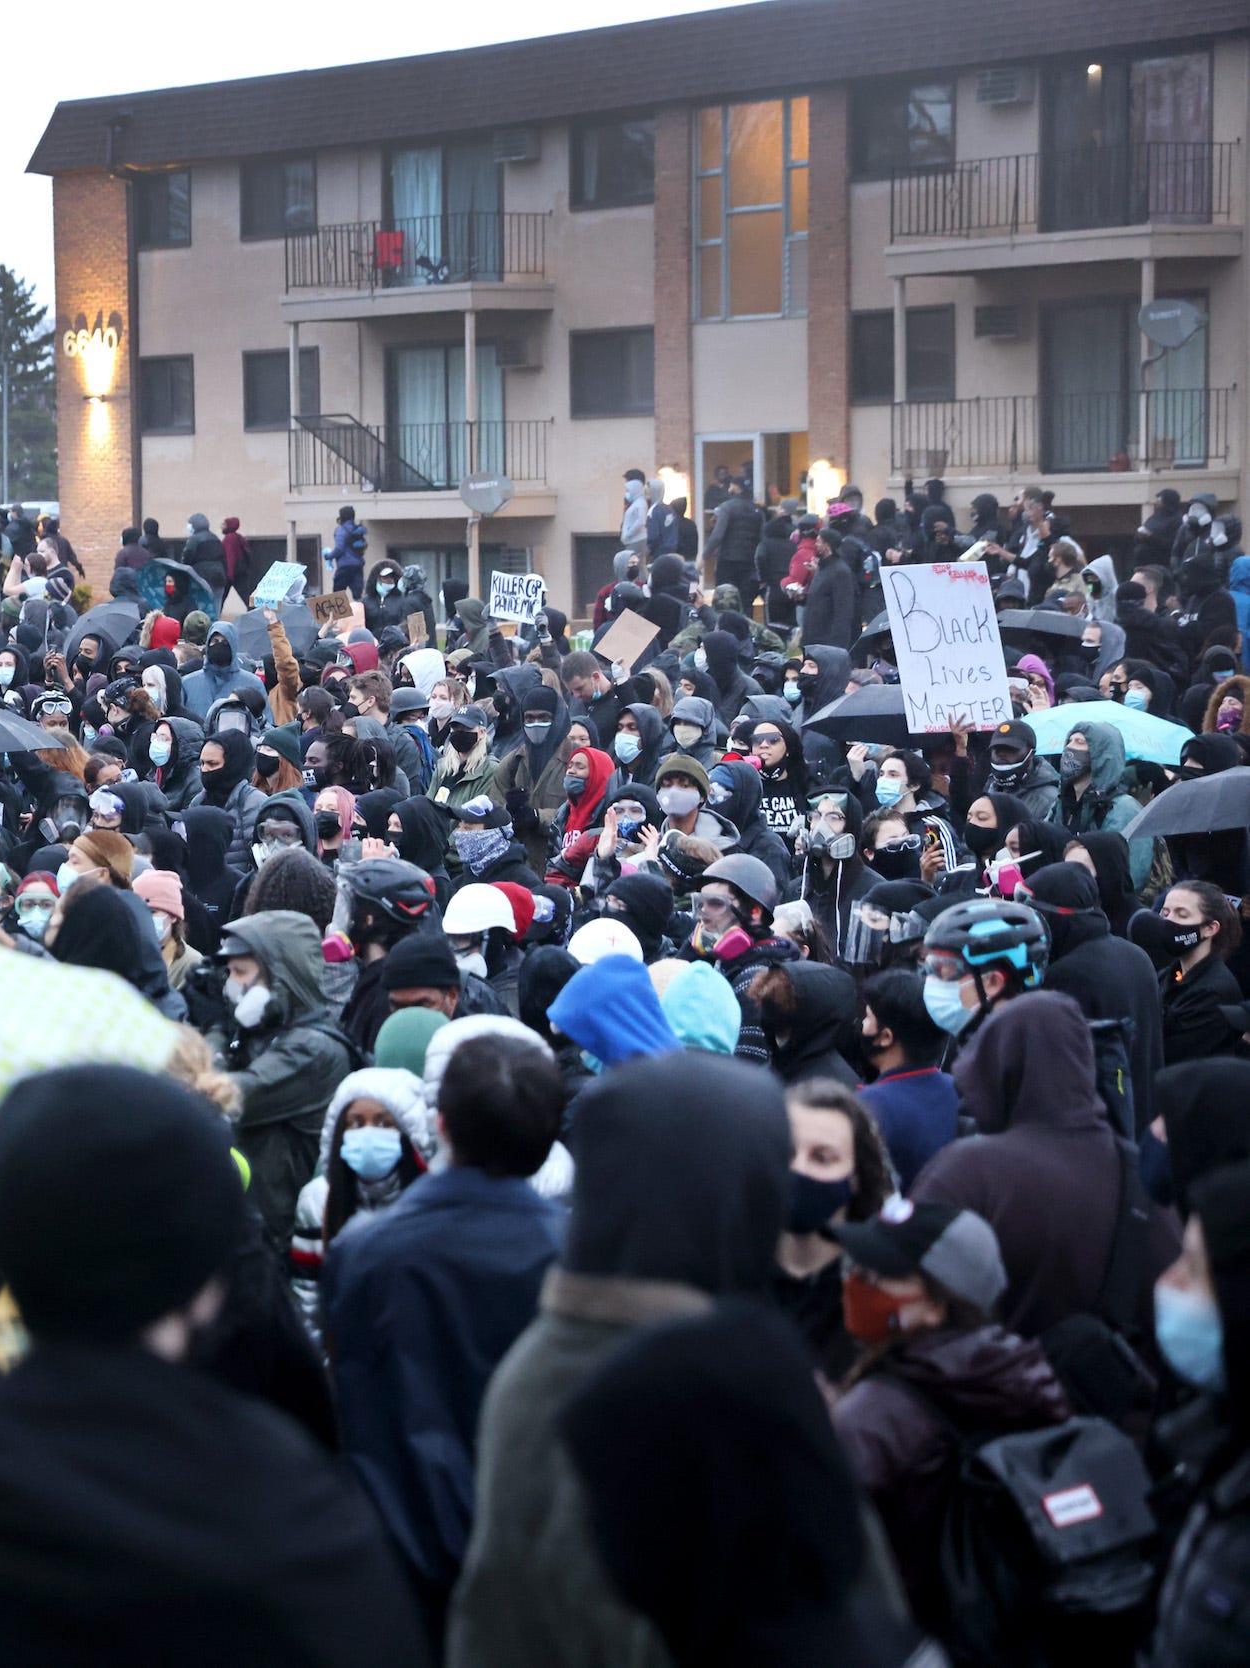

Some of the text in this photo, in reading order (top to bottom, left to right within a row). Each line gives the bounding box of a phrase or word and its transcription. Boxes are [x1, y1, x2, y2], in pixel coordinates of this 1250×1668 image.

[492, 574, 542, 598] KILLER COP
[315, 599, 348, 617] ACAB
[924, 656, 993, 686] Lives
[908, 692, 1014, 728] MATTER
